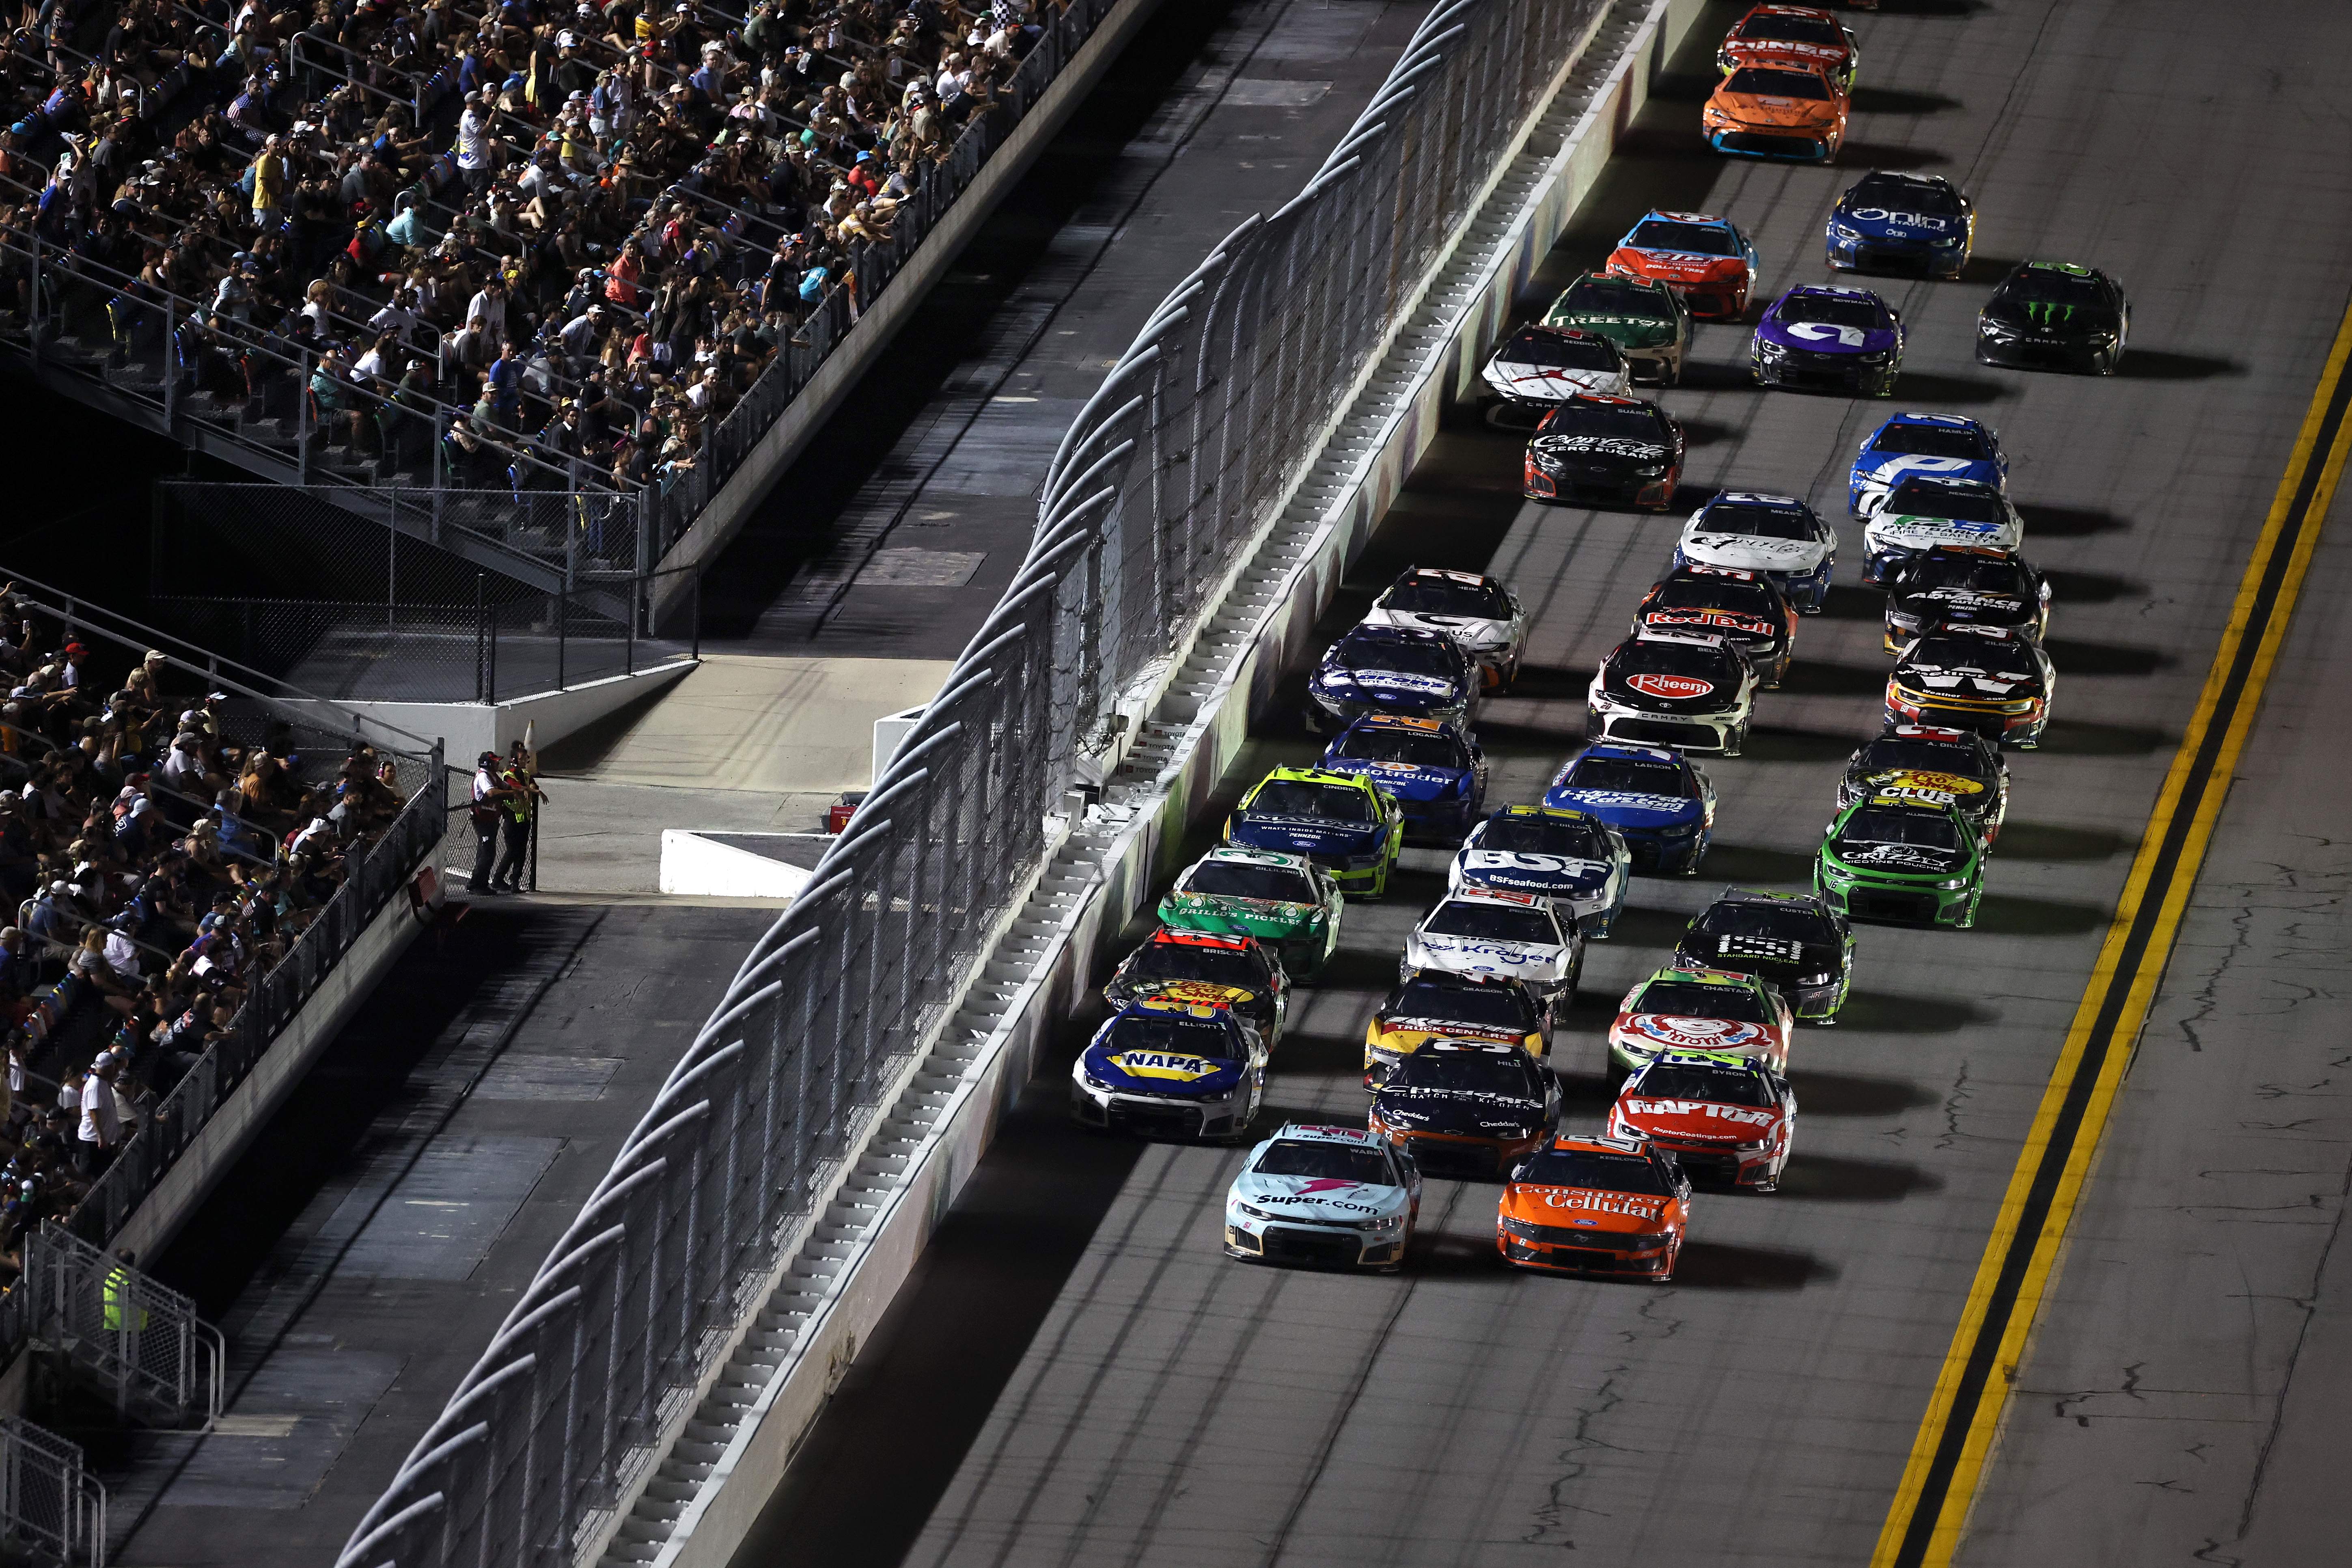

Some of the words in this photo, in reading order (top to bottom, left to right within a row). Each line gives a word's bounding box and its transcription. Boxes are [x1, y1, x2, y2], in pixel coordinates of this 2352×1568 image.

[1726, 41, 1843, 59] MINER
[1654, 253, 1704, 261] STP
[1553, 315, 1621, 327] TREE
[1623, 317, 1674, 327] TOP
[1938, 427, 1973, 436] HAMLIN
[1595, 447, 1649, 459] SUGAR
[1906, 592, 2022, 608] ADVANCE
[1646, 612, 1712, 625] Red
[1712, 615, 1775, 637] Bull
[1637, 675, 1707, 693] Rheem
[1899, 705, 1909, 713] 88
[1642, 713, 1688, 721] CAMRY
[1334, 766, 1454, 785] Autotrader
[1909, 780, 1969, 793] Shops
[1880, 787, 1956, 804] CLUB
[1255, 815, 1369, 830] MAYTAG
[1841, 852, 1952, 867] GRIZZLY
[1256, 867, 1299, 875] GILLILAND
[1897, 861, 1947, 873] POUCHES
[1490, 874, 1574, 889] BSFseafood.com
[1828, 880, 1839, 889] 16
[1179, 908, 1237, 917] GRILLO'S
[1244, 913, 1302, 926] PICKLES
[1203, 948, 1245, 957] BRISCOE
[1462, 945, 1556, 964] Kroger
[1763, 955, 1799, 965] NUCLEAR
[1703, 985, 1753, 994] CHASTAIN
[1179, 1021, 1218, 1029] ELLIOTT
[1446, 1027, 1509, 1040] CENTERS
[1125, 1053, 1202, 1074] NAPA
[1392, 1109, 1430, 1122] Cheddar's
[1626, 1099, 1775, 1127] RAPTOR
[1303, 1134, 1365, 1145] Super.com
[1653, 1126, 1738, 1140] RaptorCoatings.com
[1516, 1185, 1666, 1206] Consumer
[1257, 1194, 1381, 1216] Super.com
[1545, 1194, 1665, 1223] Cellular
